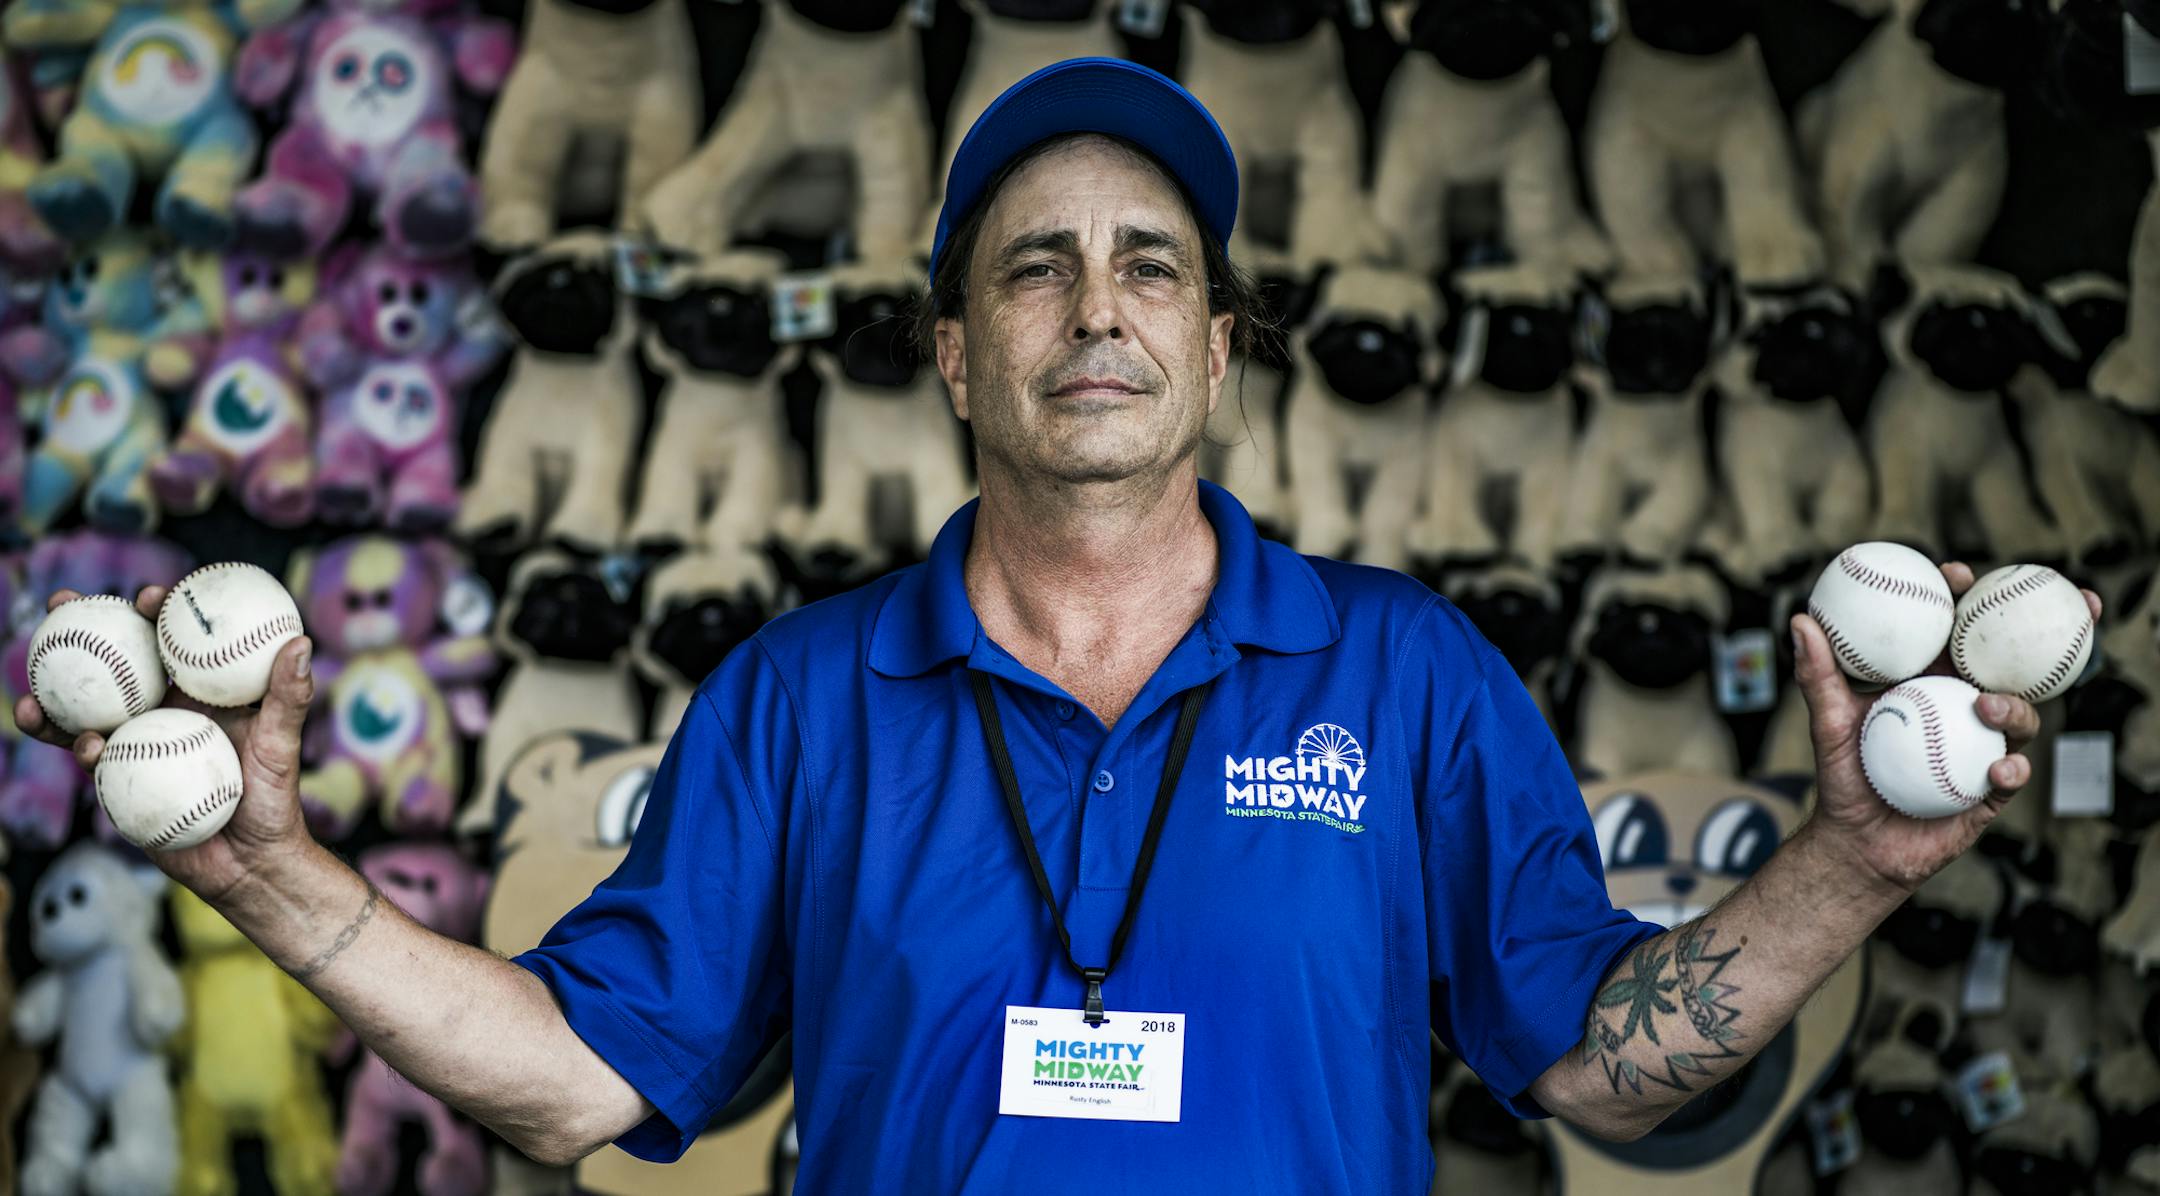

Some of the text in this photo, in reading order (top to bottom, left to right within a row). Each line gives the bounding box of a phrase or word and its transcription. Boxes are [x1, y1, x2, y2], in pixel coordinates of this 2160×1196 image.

[1225, 754, 1367, 791] MIGHTY
[1225, 780, 1367, 821] MIDWAY
[1225, 806, 1366, 834] MINNESOTA STATE FAIR
[1011, 1018, 1038, 1027] M-0583
[1141, 1020, 1176, 1033] 2018
[1035, 1039, 1145, 1061] MIGHTY
[1033, 1059, 1144, 1082] MIDWAY
[1033, 1079, 1141, 1091] MINNESOTA STATE FAIR
